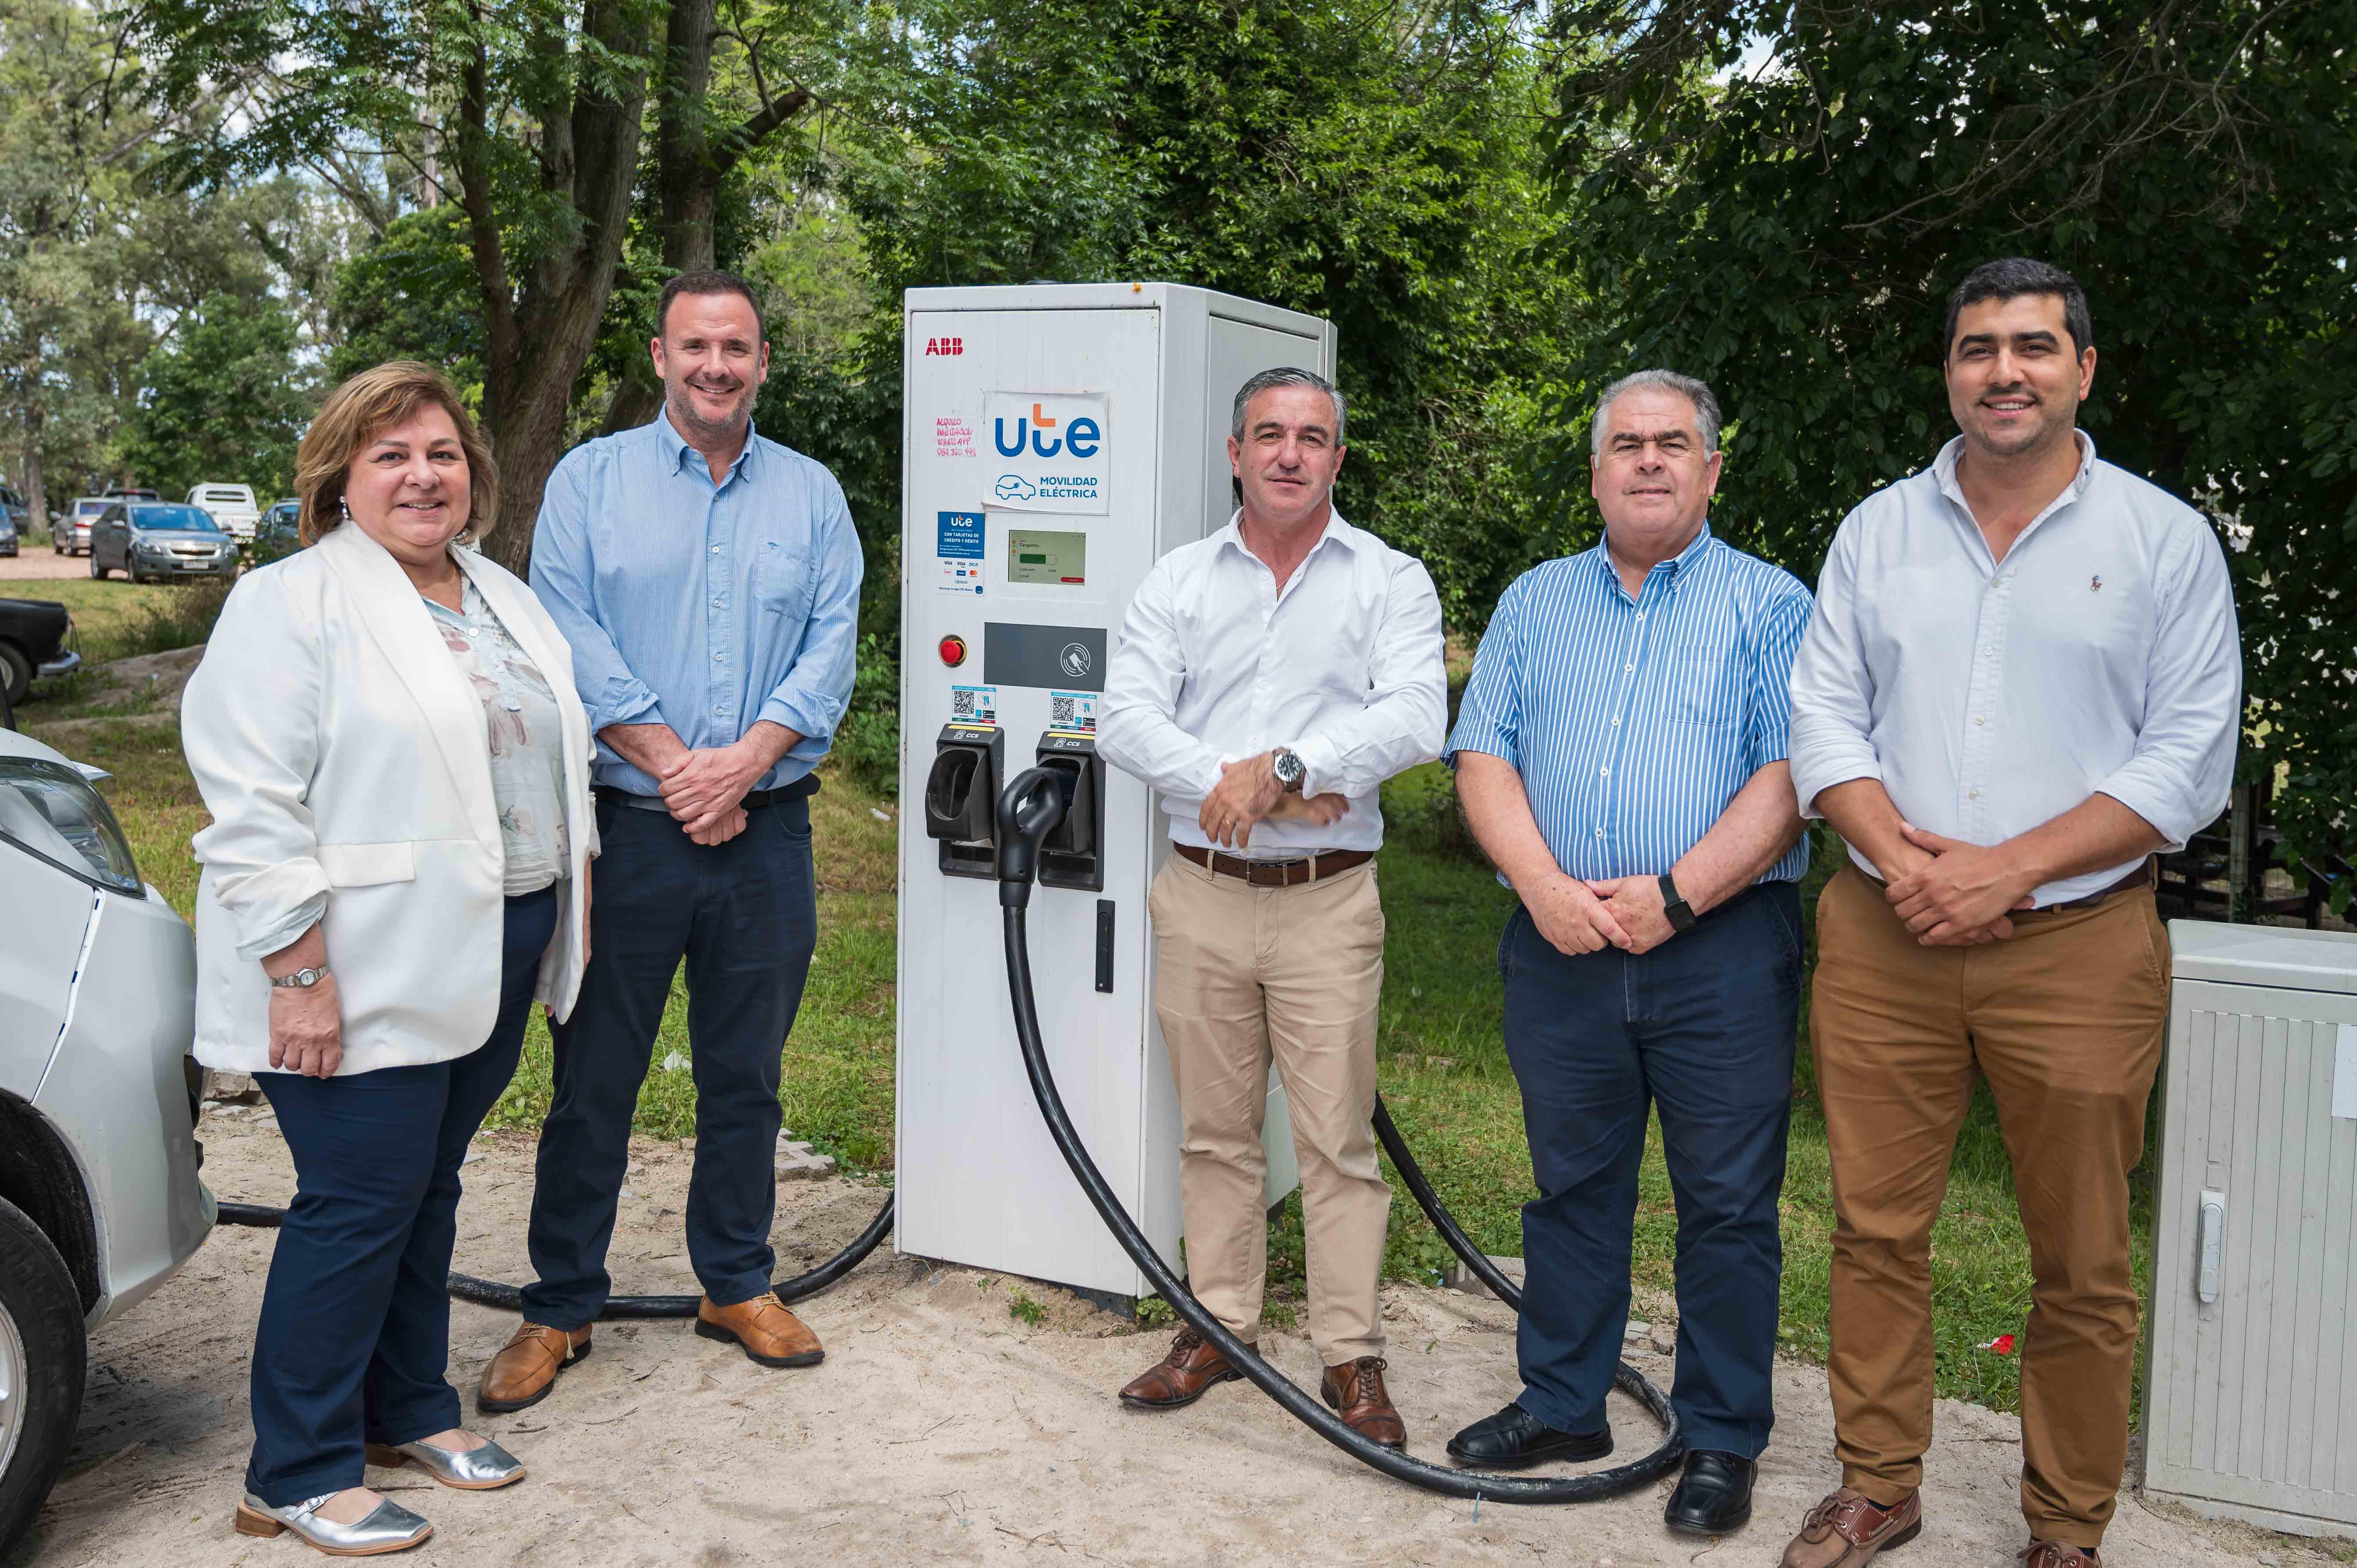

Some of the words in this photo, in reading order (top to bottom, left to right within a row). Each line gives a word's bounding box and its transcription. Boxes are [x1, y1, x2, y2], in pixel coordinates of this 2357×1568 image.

[925, 337, 963, 355] ABB
[937, 418, 961, 427] ALQUILO
[995, 403, 1100, 458] ute
[1040, 477, 1098, 486] MOVILIDAD
[1040, 487, 1098, 498] ELÉCTRICA
[951, 514, 973, 527] ute
